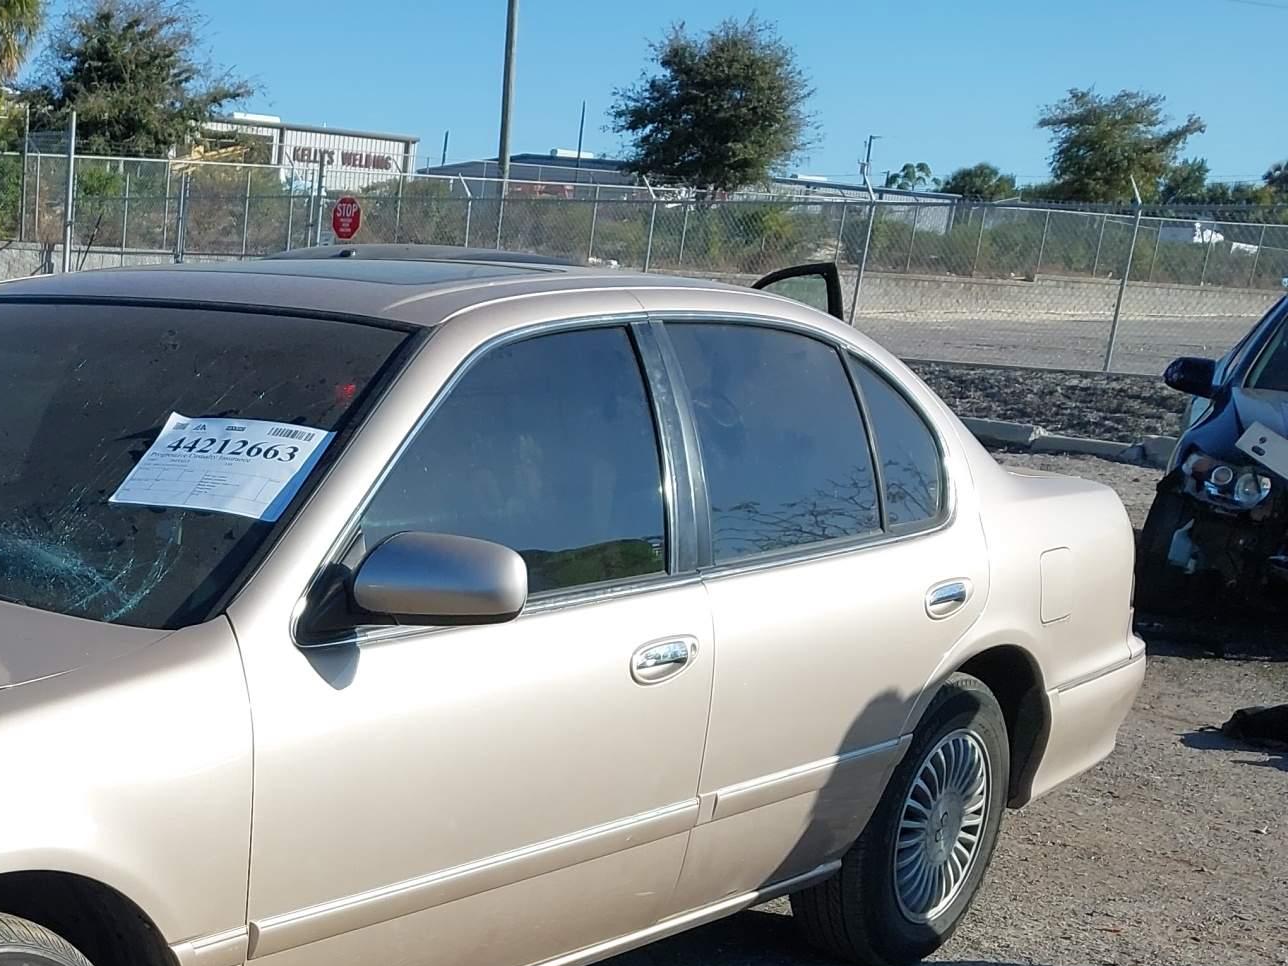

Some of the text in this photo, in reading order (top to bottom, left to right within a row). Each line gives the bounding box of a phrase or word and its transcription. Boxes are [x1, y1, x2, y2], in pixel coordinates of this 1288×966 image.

[341, 151, 392, 170] WELDING
[336, 203, 358, 217] STOP
[166, 435, 300, 463] 44212663
